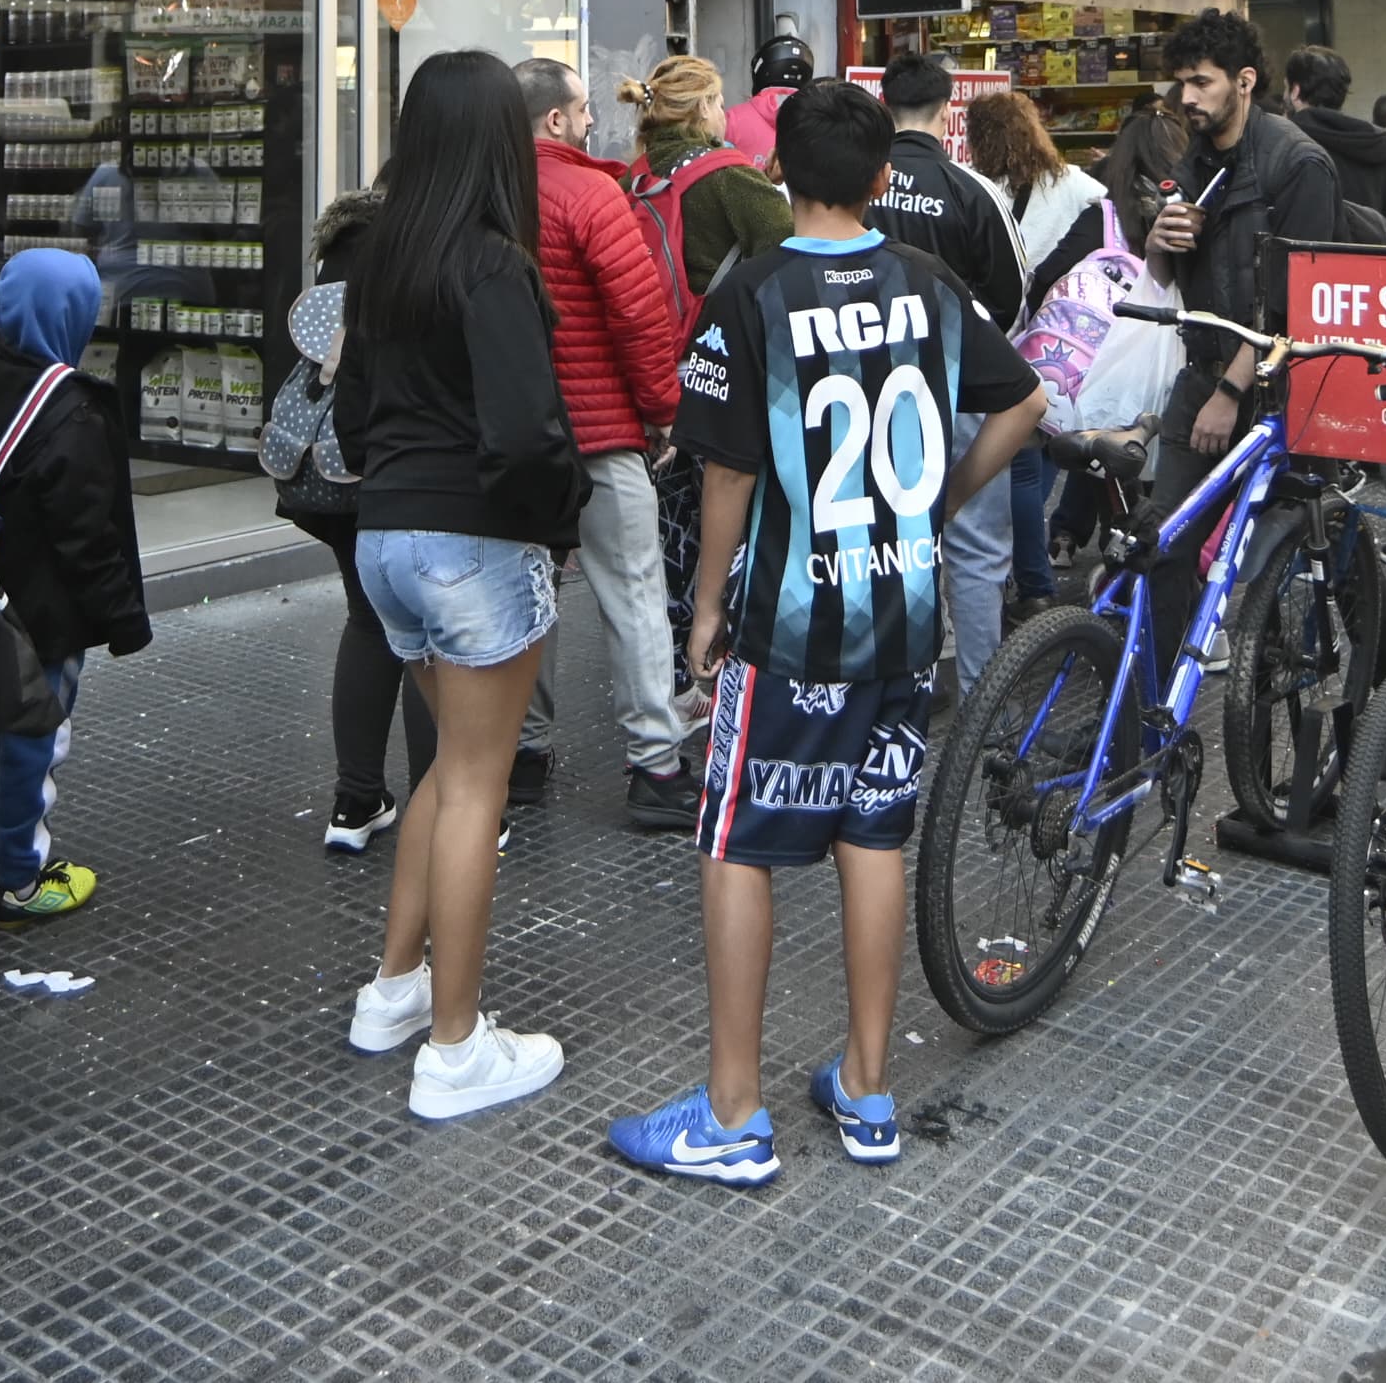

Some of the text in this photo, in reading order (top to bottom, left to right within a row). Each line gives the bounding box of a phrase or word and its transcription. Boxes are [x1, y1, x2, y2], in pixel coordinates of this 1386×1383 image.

[962, 81, 973, 101] EN
[824, 268, 874, 284] Kappa
[789, 295, 929, 358] RCA
[1312, 282, 1369, 327] OFF
[684, 370, 730, 402] Ciudad
[688, 352, 727, 381] Banco
[805, 364, 946, 534] 20
[806, 533, 943, 587] CVITANICH
[849, 772, 921, 816] eguros
